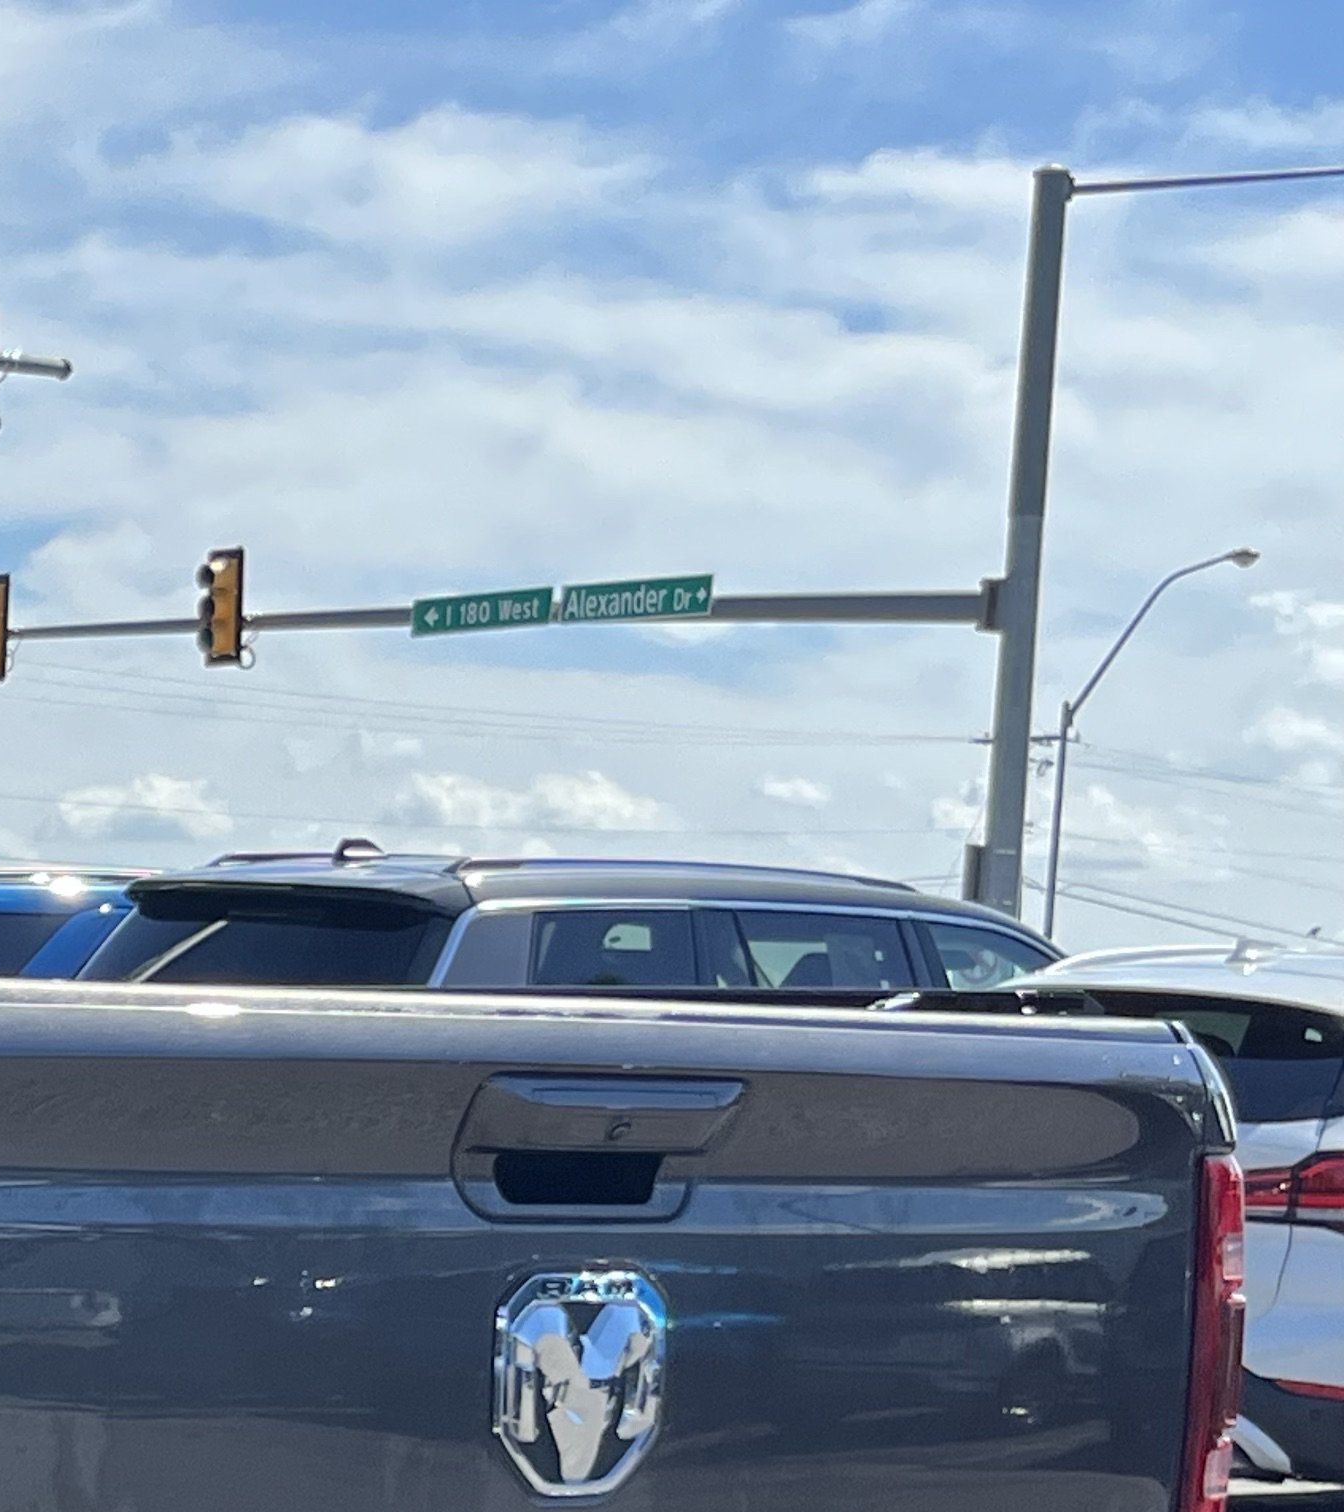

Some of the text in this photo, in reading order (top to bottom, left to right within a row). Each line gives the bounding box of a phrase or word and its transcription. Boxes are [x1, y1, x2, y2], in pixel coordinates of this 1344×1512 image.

[459, 601, 491, 625] 180
[498, 597, 541, 622] West
[564, 584, 693, 619] Alexander Dr
